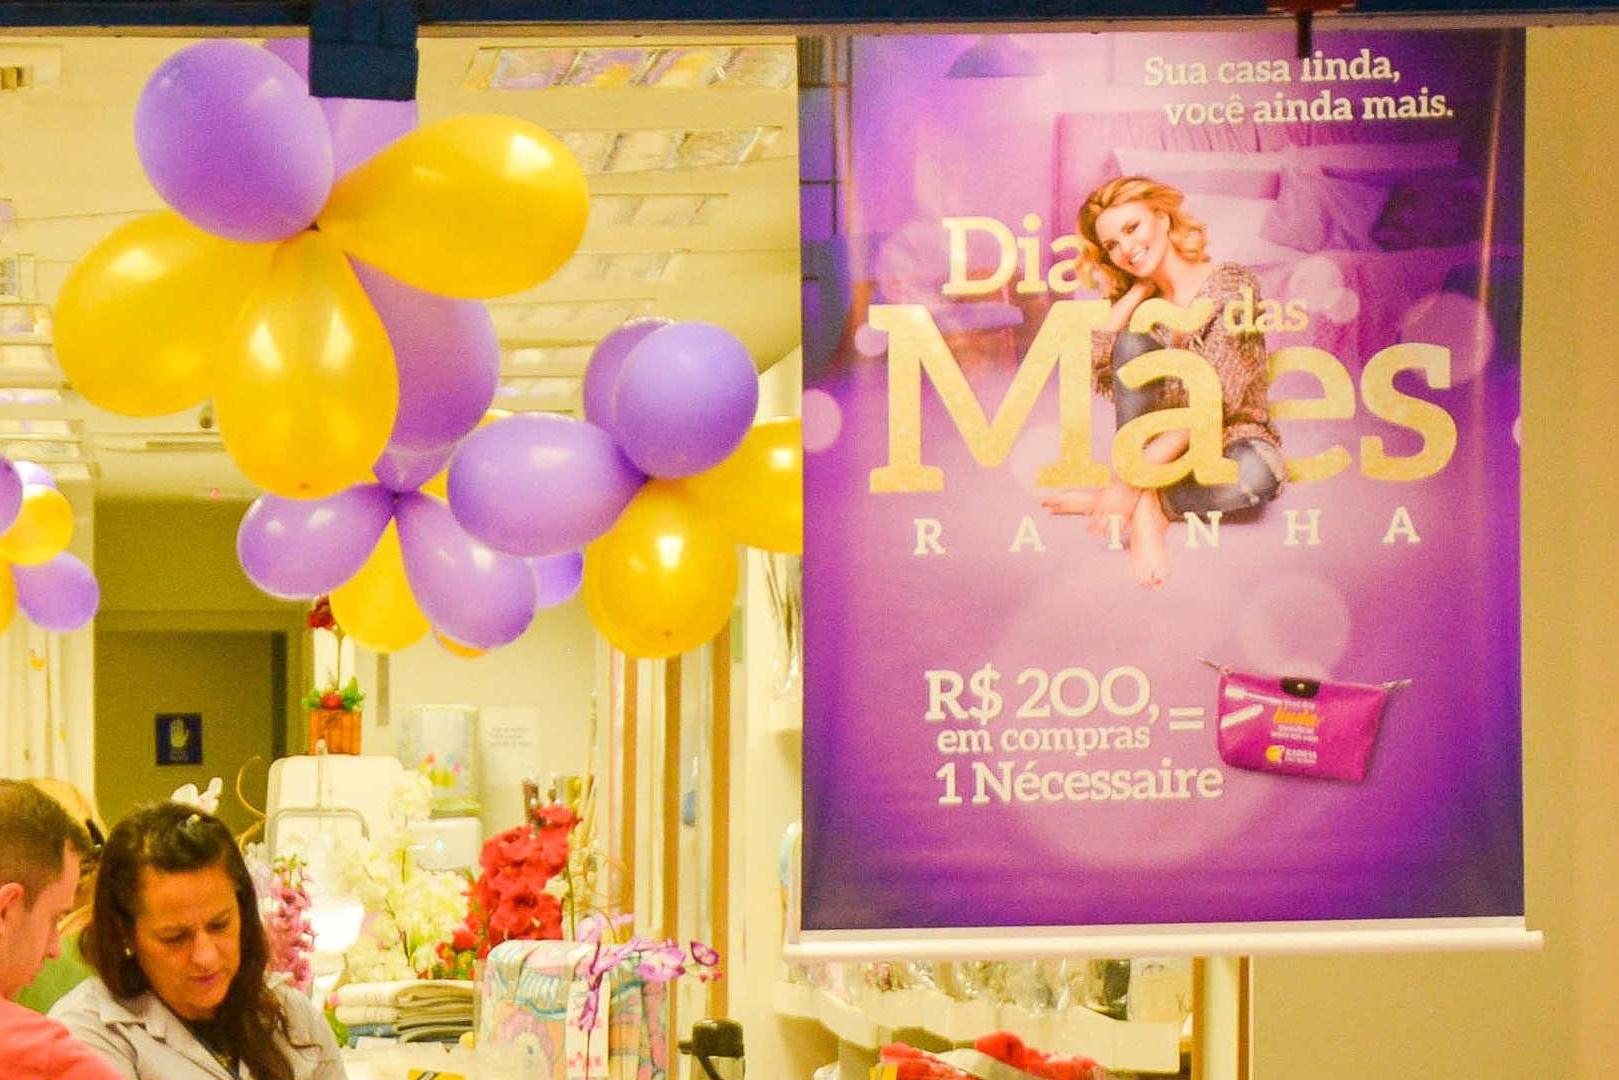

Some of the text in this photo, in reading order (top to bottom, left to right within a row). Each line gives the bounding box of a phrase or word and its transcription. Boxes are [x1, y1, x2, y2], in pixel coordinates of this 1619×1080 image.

[1144, 49, 1400, 86] Sua casa linda,
[1163, 87, 1455, 126] você ainda mais.
[942, 214, 1102, 296] Dia
[1222, 286, 1310, 336] das
[867, 298, 1459, 494] Mães
[913, 506, 1421, 556] RAINHA
[923, 662, 1003, 725] R$
[936, 725, 1151, 757] em compras
[934, 757, 1224, 805] 1 Nécessaire
